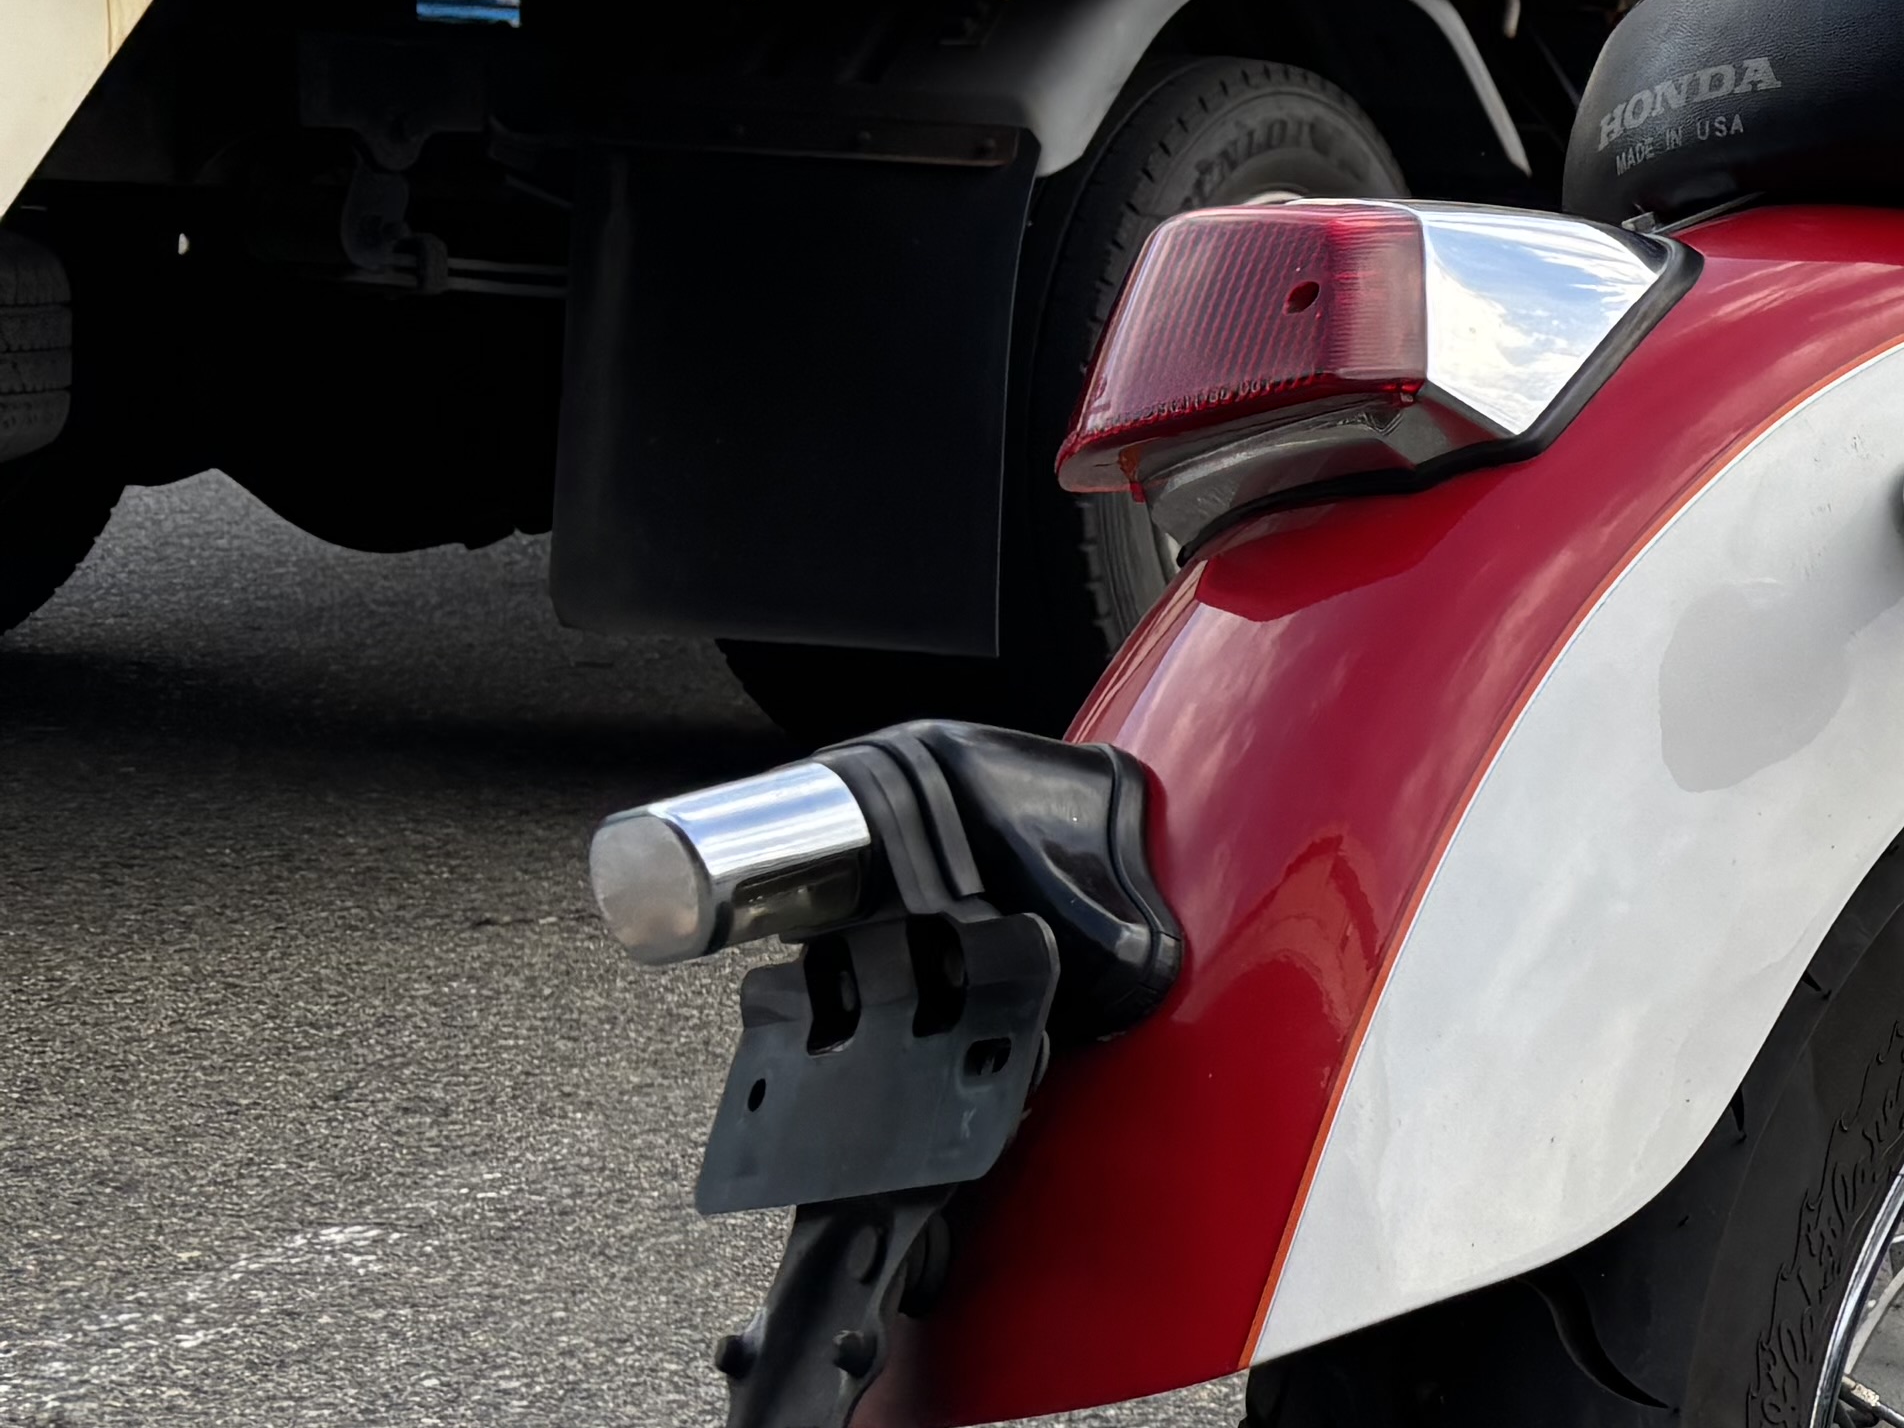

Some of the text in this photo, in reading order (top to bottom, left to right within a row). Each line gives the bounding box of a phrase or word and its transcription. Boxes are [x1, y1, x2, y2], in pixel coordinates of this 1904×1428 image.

[1597, 57, 1782, 152] HONDA
[1616, 113, 1745, 176] MADE IN USA
